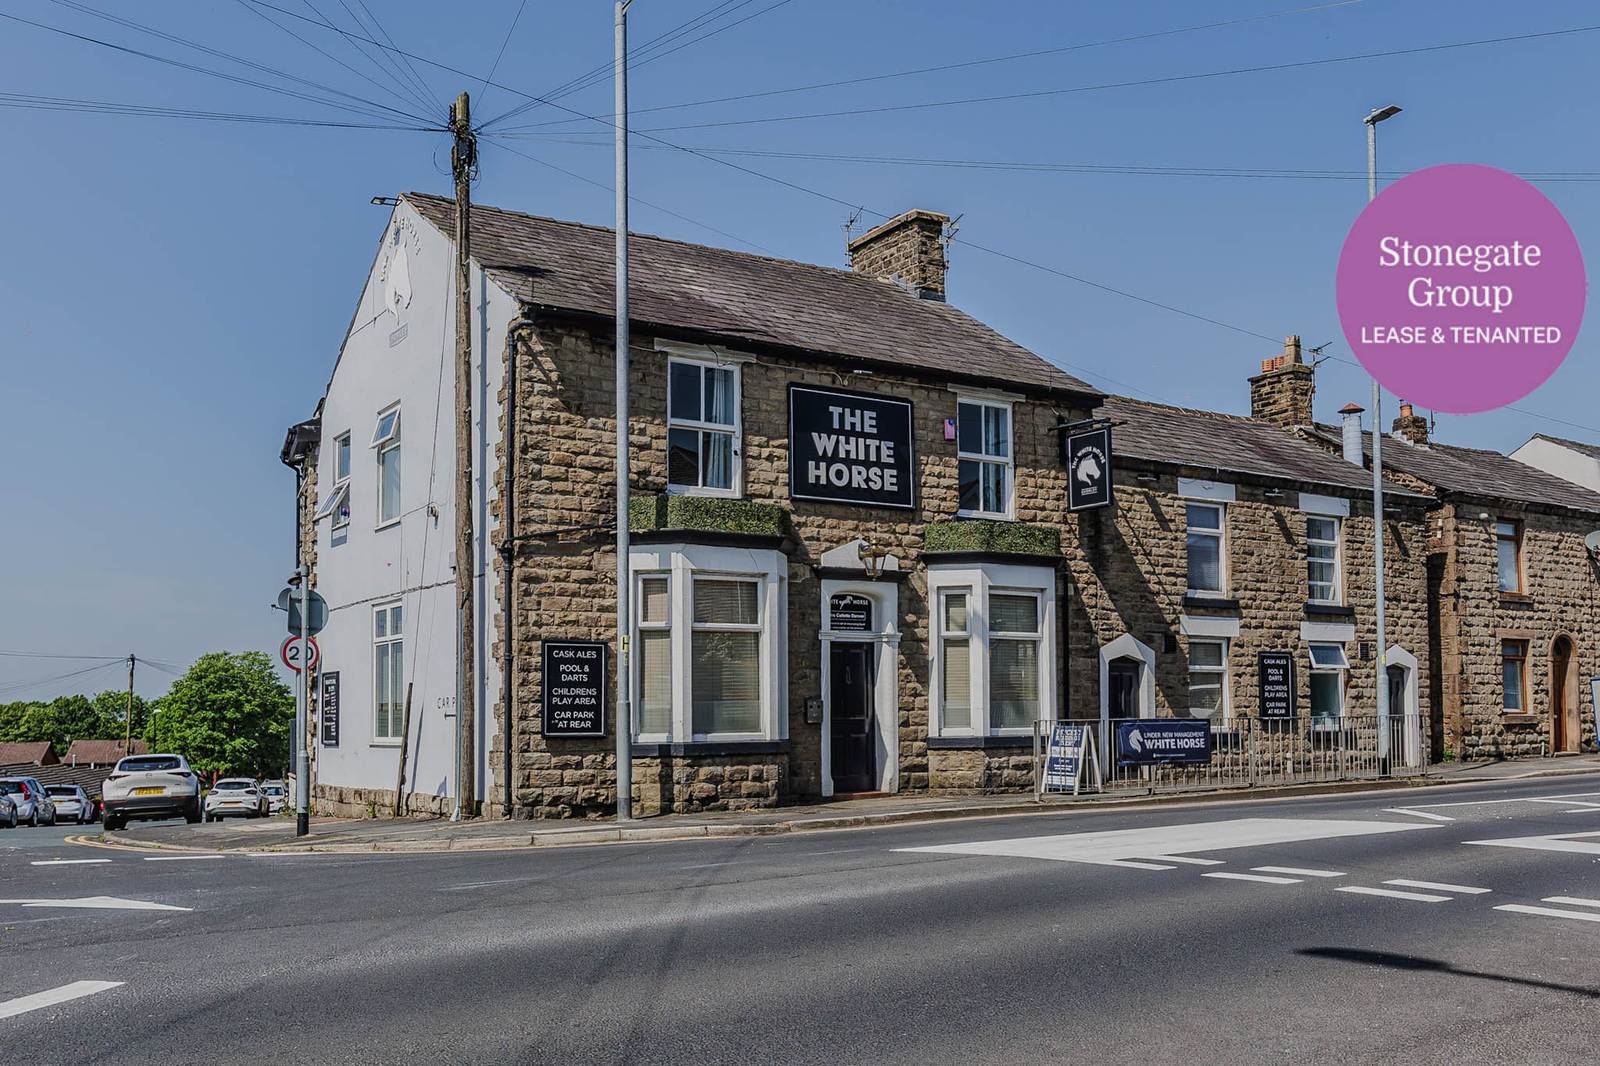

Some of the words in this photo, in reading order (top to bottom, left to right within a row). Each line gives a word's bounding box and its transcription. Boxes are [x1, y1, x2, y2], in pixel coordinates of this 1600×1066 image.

[828, 405, 878, 434] THE
[811, 432, 895, 464] WHITE
[808, 460, 898, 492] HORSE
[552, 650, 575, 658] CASK
[576, 650, 597, 659] ALES
[559, 664, 582, 672] POOL
[583, 664, 590, 672] &
[552, 687, 597, 696] CHILDRENS
[552, 697, 573, 705] PLAY
[574, 697, 597, 705] AREA
[554, 711, 571, 719] CAR
[573, 711, 594, 719] PARK
[557, 720, 568, 729] AT
[569, 720, 592, 729] REAR
[1144, 738, 1176, 749] WHITE
[1177, 738, 1206, 749] HORSE
